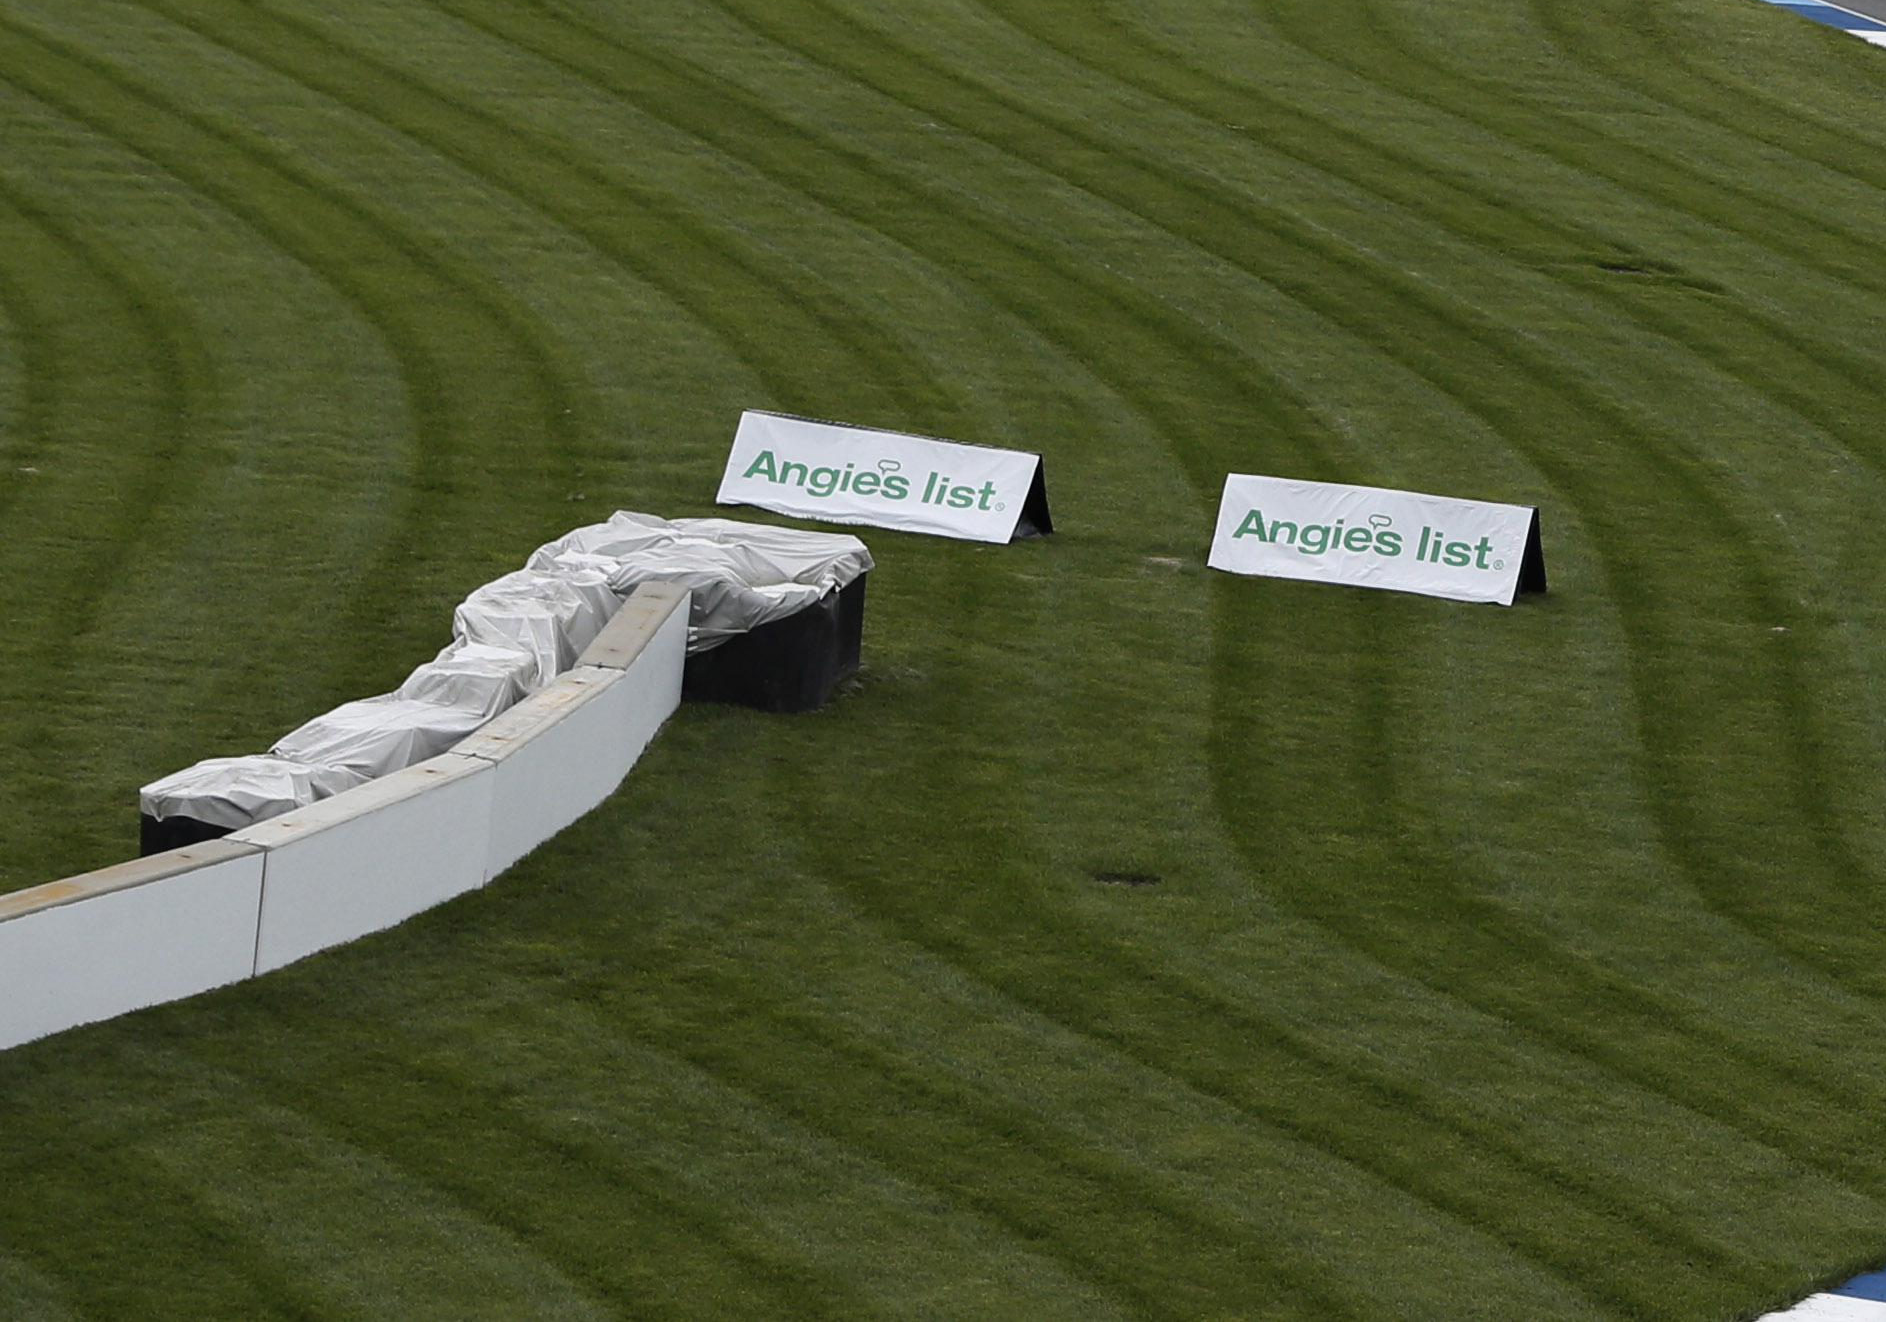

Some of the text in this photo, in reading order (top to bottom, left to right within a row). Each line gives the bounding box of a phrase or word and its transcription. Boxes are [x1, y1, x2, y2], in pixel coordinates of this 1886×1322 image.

[745, 452, 994, 509] Angie's list
[1234, 510, 1491, 568] Angie's list
